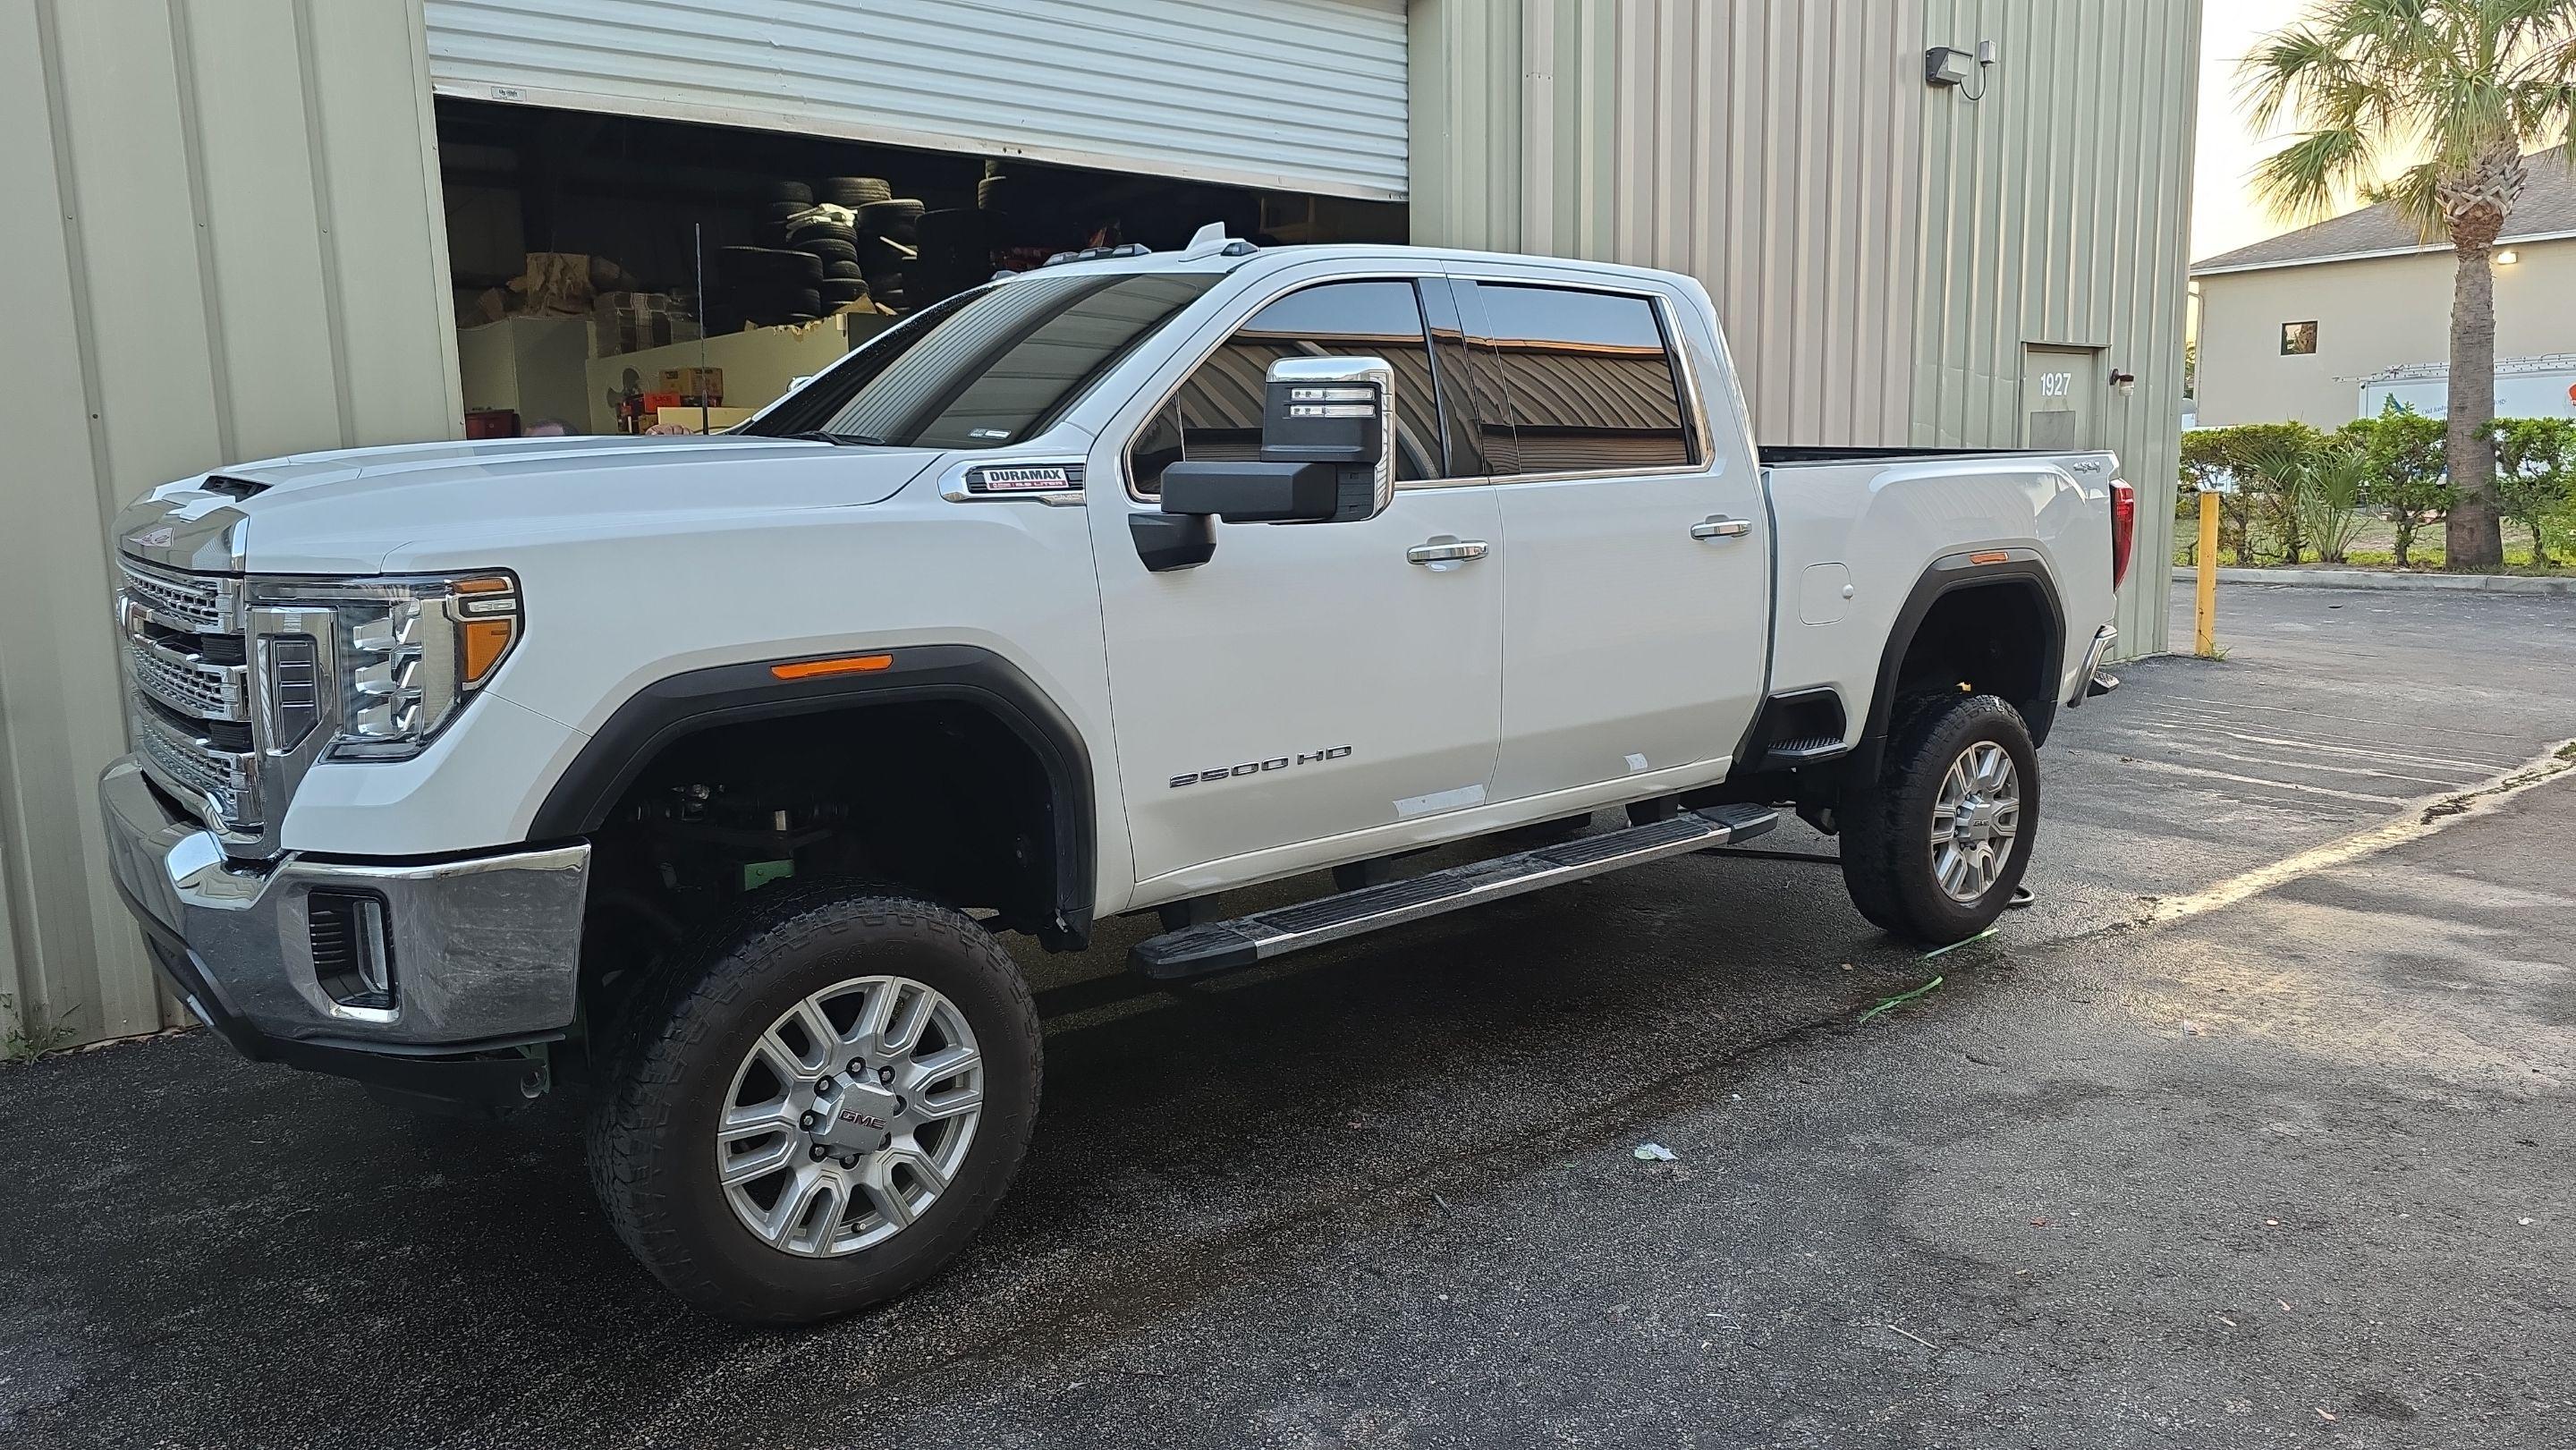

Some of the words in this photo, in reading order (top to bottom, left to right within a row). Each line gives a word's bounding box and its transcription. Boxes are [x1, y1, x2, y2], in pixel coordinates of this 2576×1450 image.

[2040, 372, 2072, 396] 1927
[989, 470, 1062, 481] DURAMAX
[1169, 757, 1289, 788] 2500
[1297, 744, 1352, 765] HD
[839, 1109, 886, 1130] GMC
